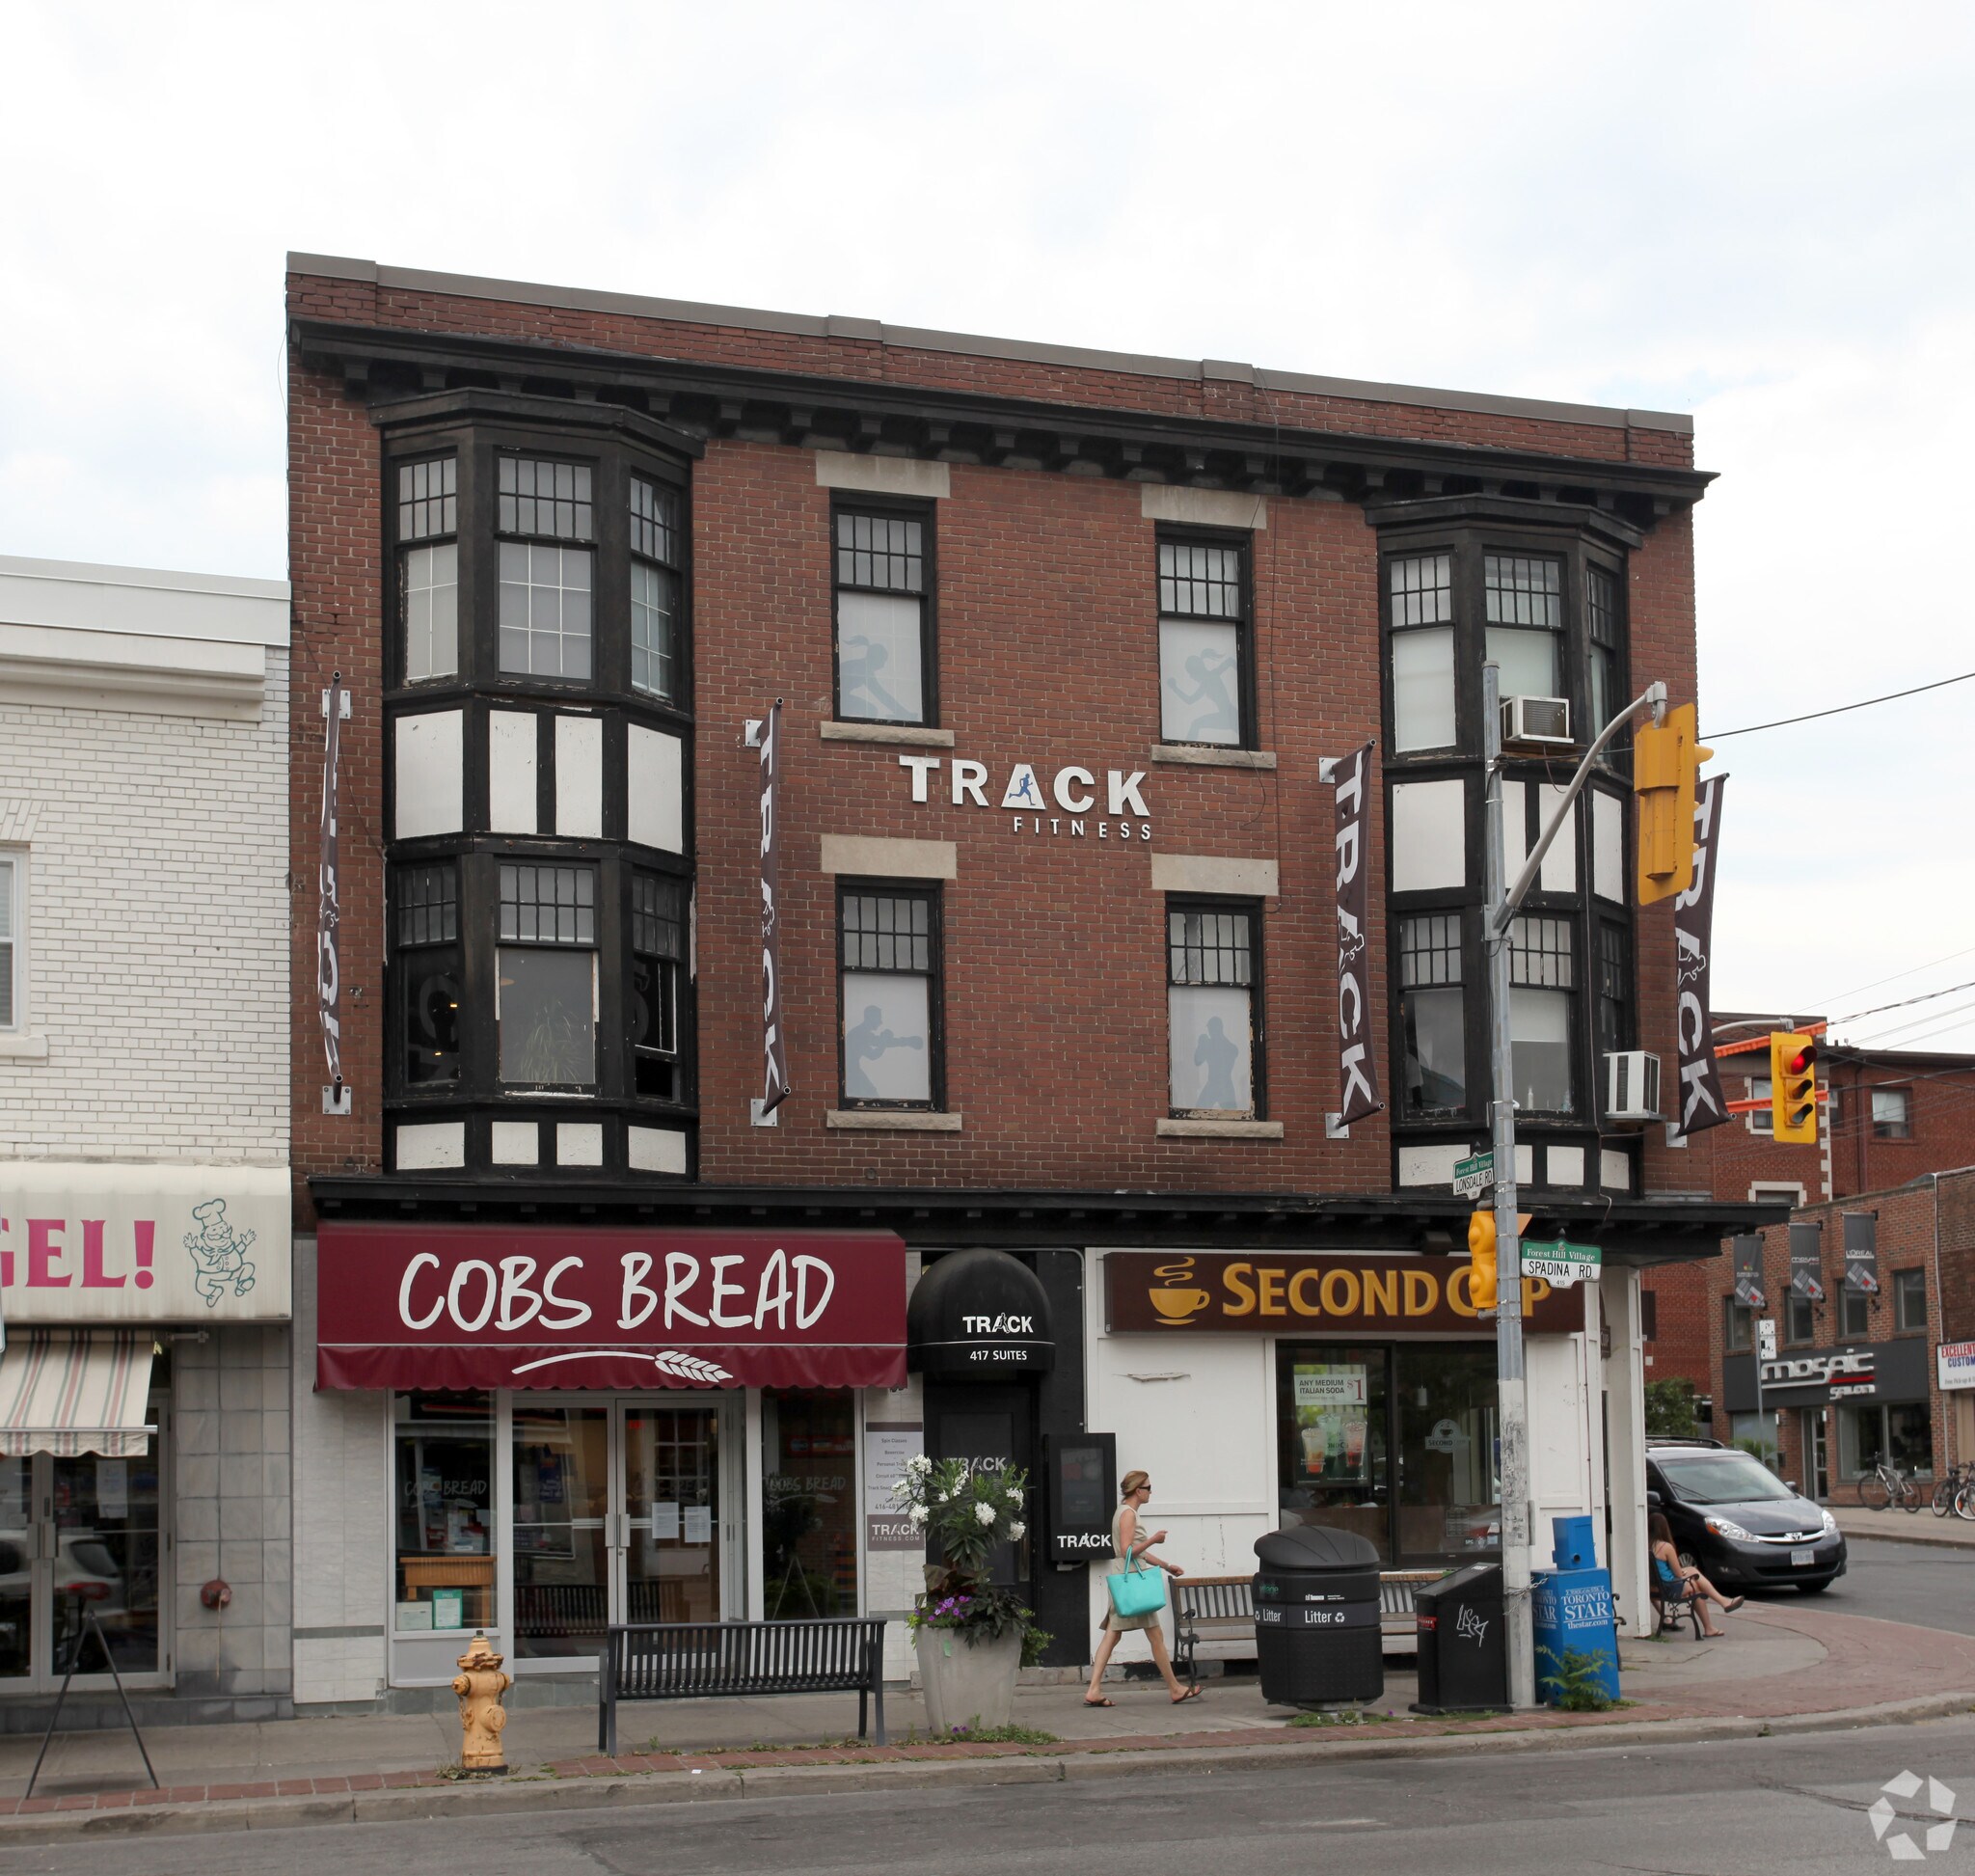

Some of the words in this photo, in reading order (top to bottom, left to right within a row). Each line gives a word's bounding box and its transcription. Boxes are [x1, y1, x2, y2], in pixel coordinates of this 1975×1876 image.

[899, 755, 1150, 816] TRACK
[1014, 817, 1151, 840] FITNESS
[1335, 750, 1371, 1117] TRACK
[1455, 1173, 1483, 1192] LONSDALE
[1527, 1248, 1551, 1258] Forest
[1552, 1249, 1566, 1259] Hill
[1569, 1251, 1595, 1263] Village
[1529, 1261, 1570, 1277] SPADINA
[398, 1252, 592, 1332] COBS
[616, 1248, 835, 1330] BREAD
[1222, 1263, 1440, 1318] SECOND
[1447, 1264, 1552, 1318] CP
[962, 1313, 1034, 1334] TRACK
[970, 1350, 988, 1361] 417
[992, 1350, 1028, 1361] SUITES
[444, 1480, 487, 1495] BREAD
[872, 1523, 919, 1536] TRACK
[1057, 1533, 1112, 1548] TRACK
[1561, 1591, 1610, 1605] TORONTO
[1262, 1608, 1282, 1622] Litter
[1305, 1610, 1332, 1623] Litter
[1564, 1602, 1610, 1620] STAR
[1567, 1619, 1609, 1630] thestar.com
